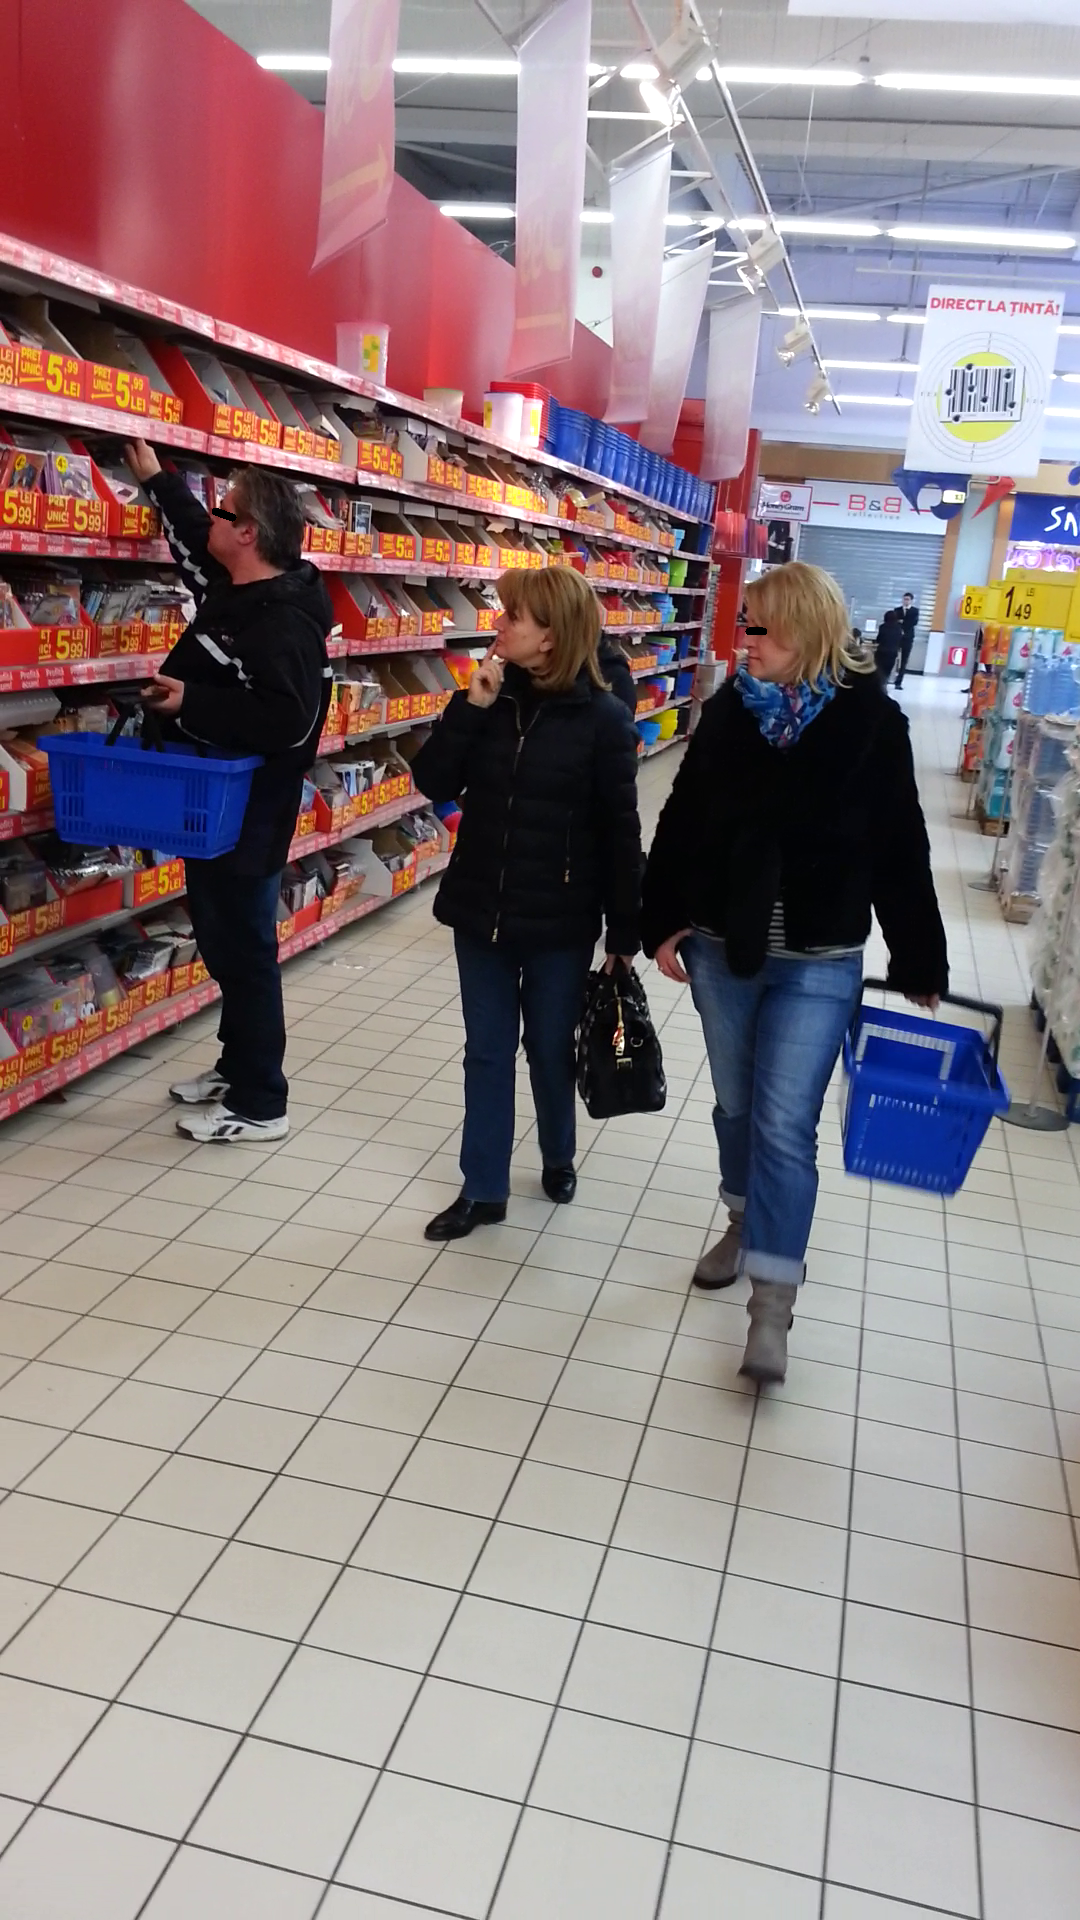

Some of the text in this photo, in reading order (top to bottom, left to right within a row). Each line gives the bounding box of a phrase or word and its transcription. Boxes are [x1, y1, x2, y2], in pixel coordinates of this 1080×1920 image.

[930, 297, 986, 312] DIRECT
[987, 300, 1006, 312] LA
[46, 354, 63, 393] 5
[64, 380, 81, 399] LEI
[116, 371, 130, 408] 5
[130, 396, 146, 413] LEI
[164, 396, 173, 423] 5
[232, 410, 244, 438] 5
[259, 418, 270, 445] 5
[372, 444, 382, 469] 5
[3, 489, 18, 524] 5
[20, 491, 33, 504] LEI
[90, 501, 102, 512] LEI
[18, 507, 32, 526] 99
[47, 511, 70, 523] UNIC!
[73, 499, 88, 531] 5
[88, 515, 101, 532] 99
[140, 506, 150, 537] 5
[1044, 505, 1080, 537] SA
[325, 529, 333, 552] 5
[395, 536, 405, 558] 5
[964, 596, 972, 615] 8
[1005, 585, 1016, 618] 1
[1014, 603, 1032, 620] 49
[56, 630, 70, 659] 5
[72, 629, 83, 640] LEI
[120, 626, 130, 653] 5
[168, 623, 179, 650] 5
[70, 642, 83, 658] 99
[158, 866, 169, 895] 5
[170, 877, 182, 891] LEI
[35, 905, 48, 935] 5
[106, 1004, 119, 1033] 5
[50, 1035, 66, 1065] 5
